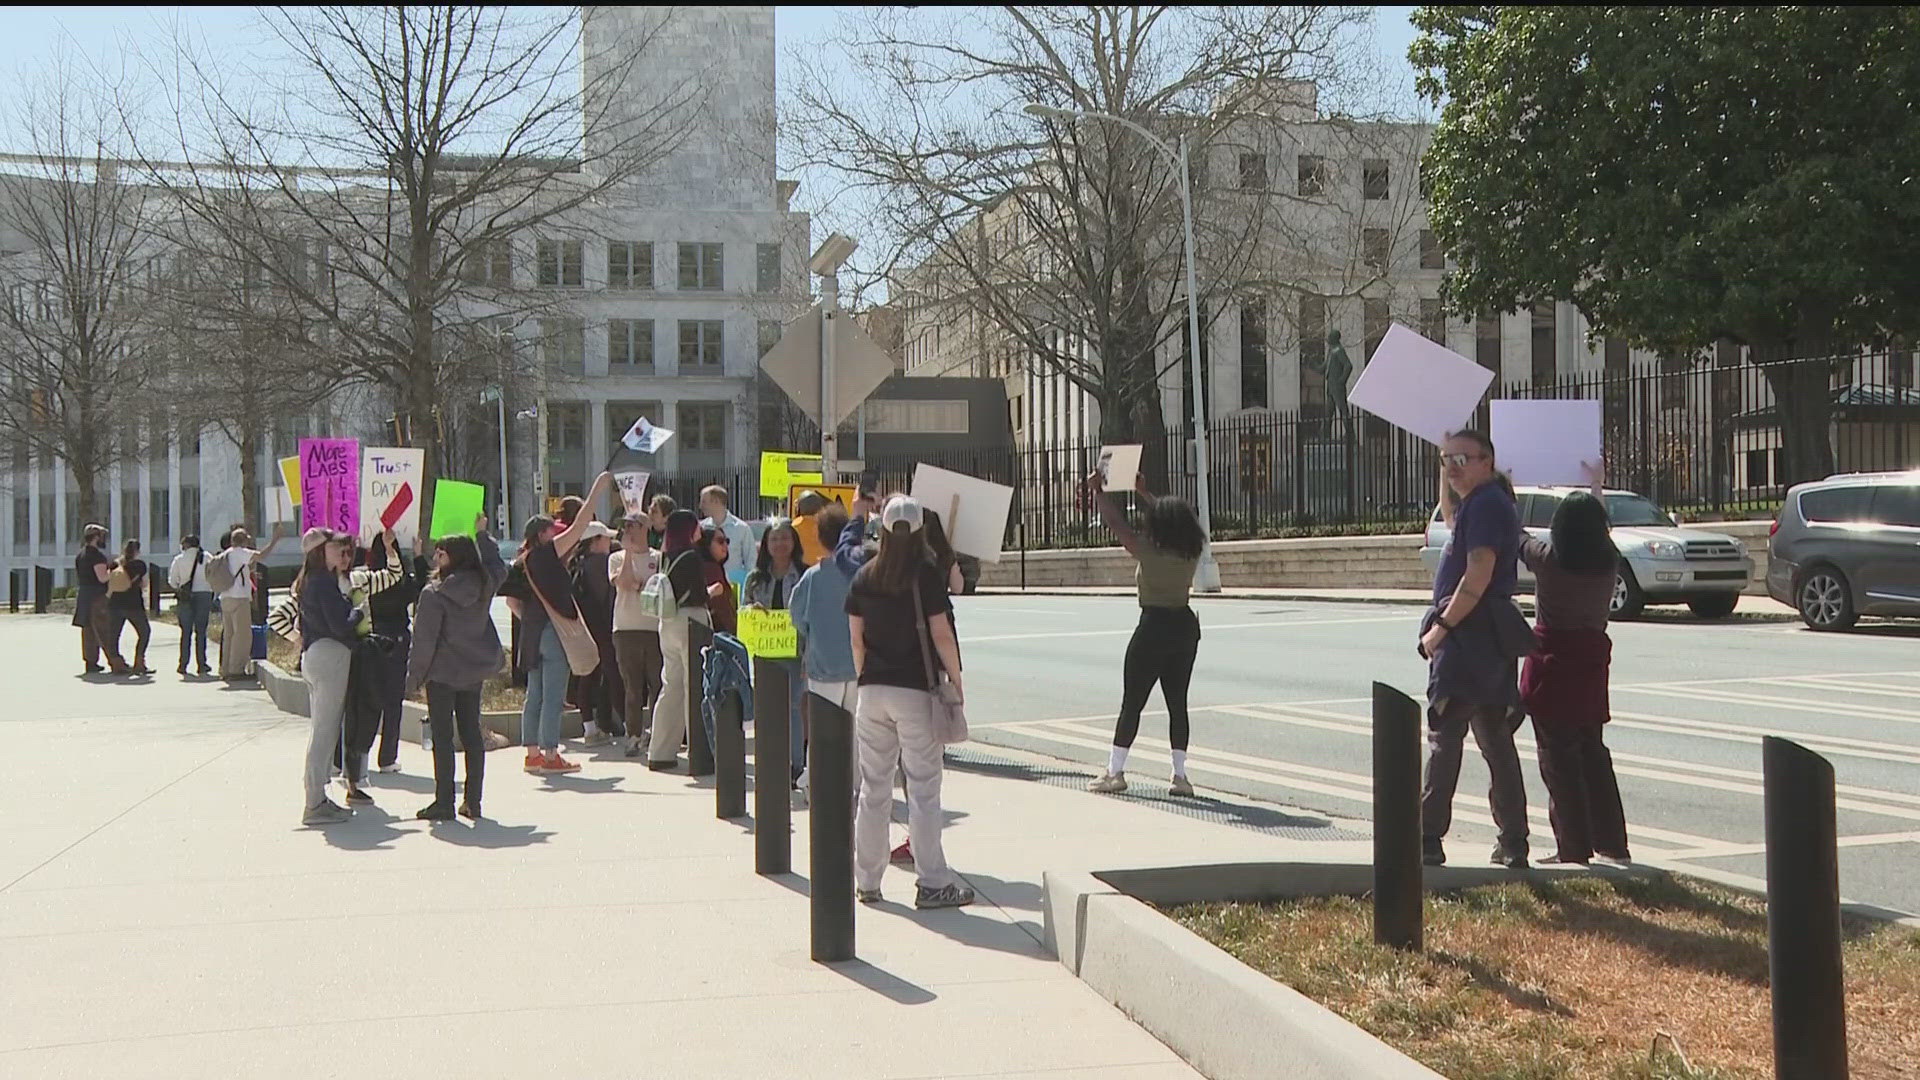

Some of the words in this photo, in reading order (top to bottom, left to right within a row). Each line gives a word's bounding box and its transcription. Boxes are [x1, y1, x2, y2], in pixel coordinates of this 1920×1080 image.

[308, 442, 347, 463] More
[308, 460, 348, 479] LABS
[370, 456, 411, 474] Trust
[371, 480, 400, 497] DAT
